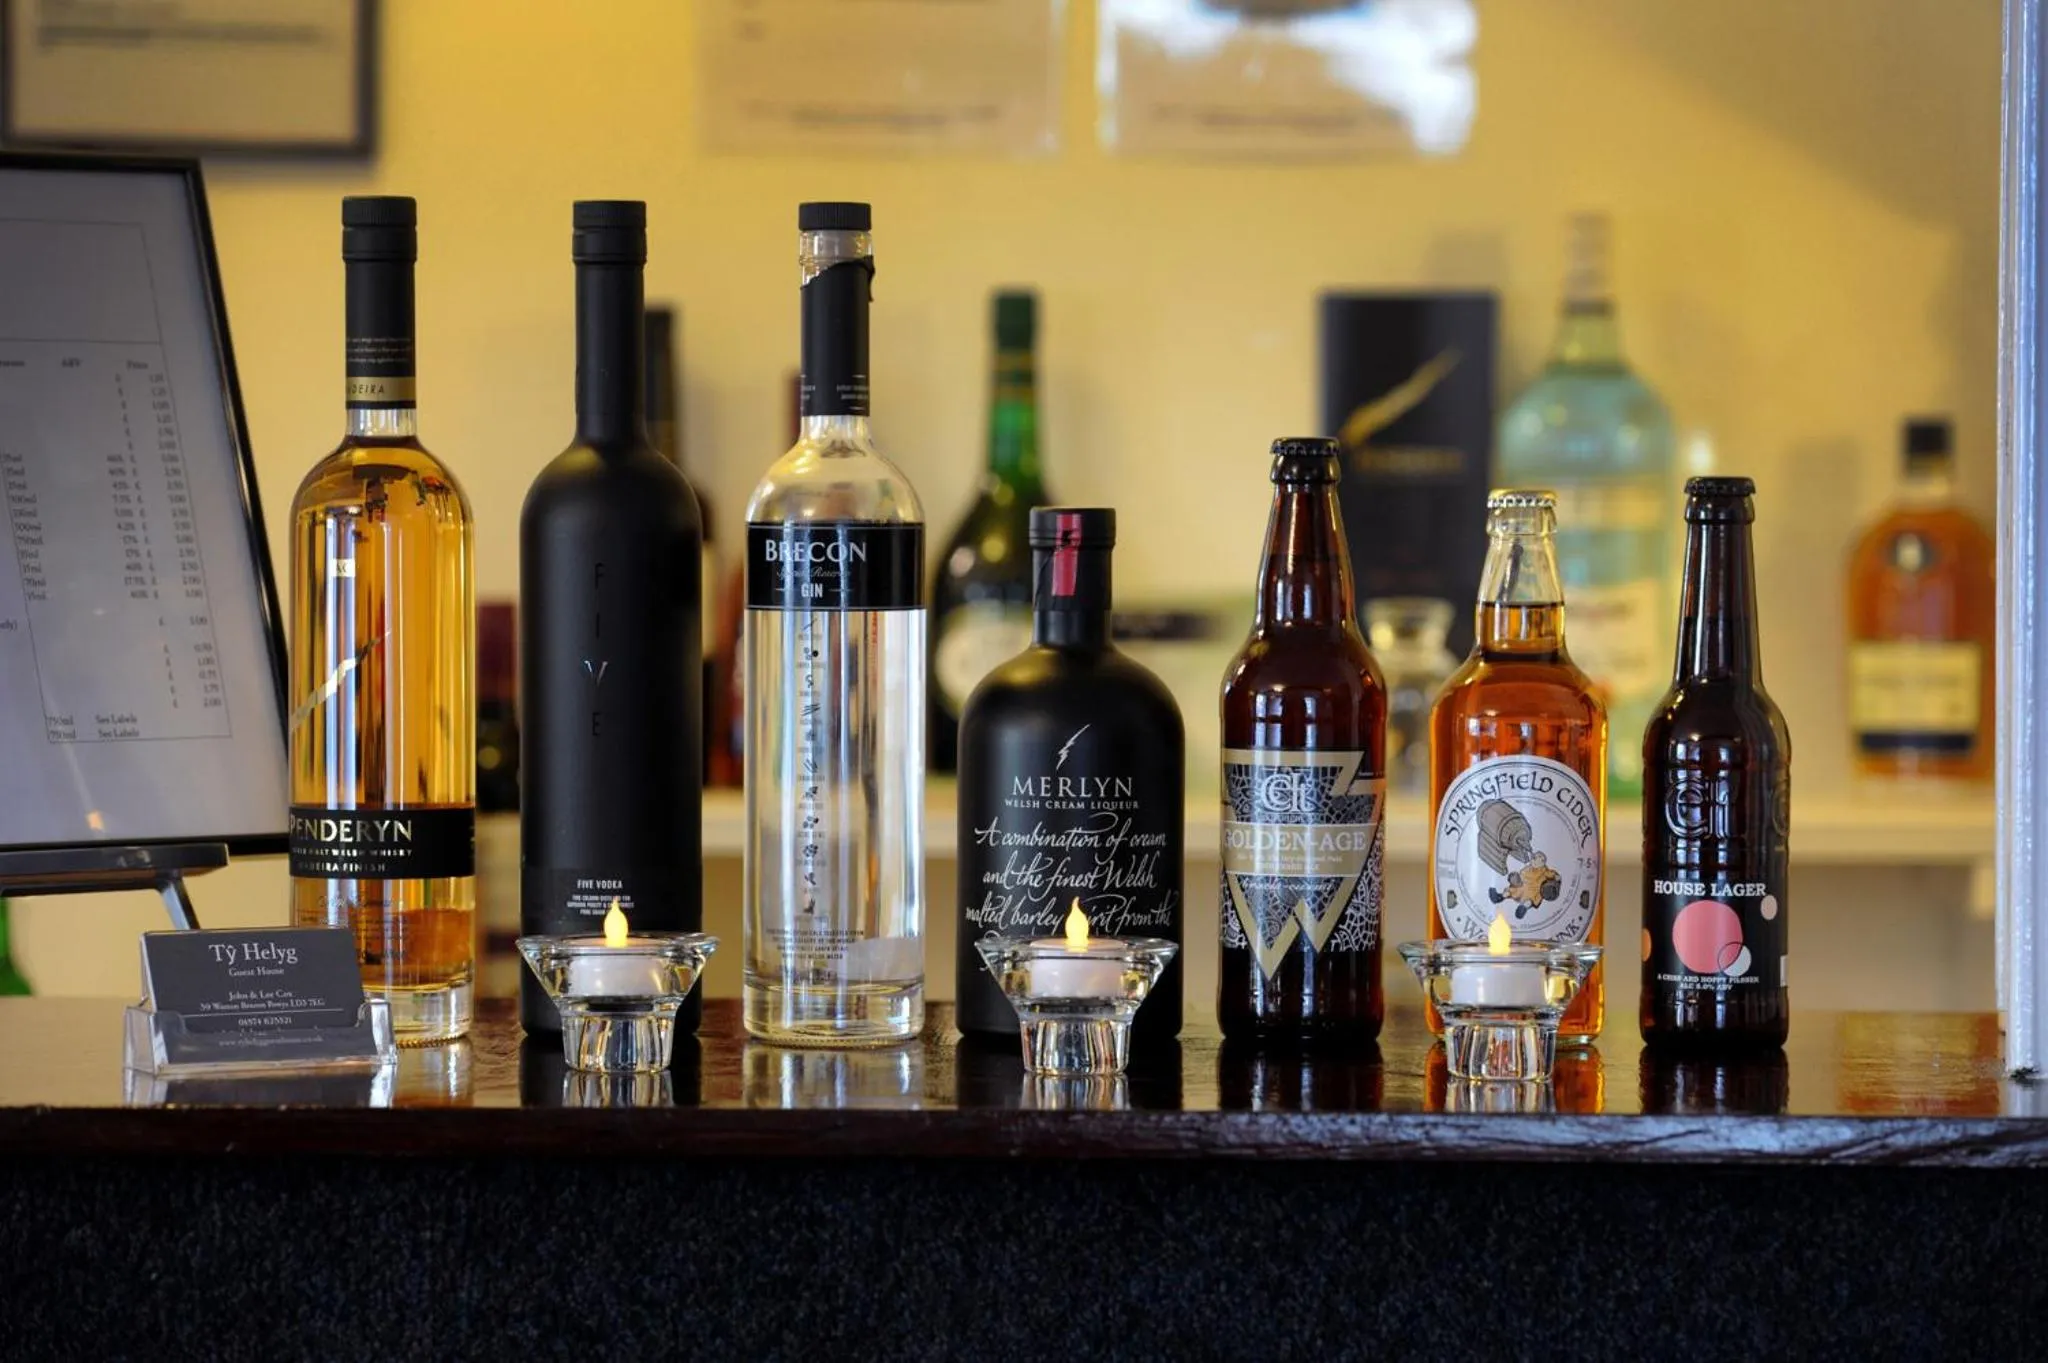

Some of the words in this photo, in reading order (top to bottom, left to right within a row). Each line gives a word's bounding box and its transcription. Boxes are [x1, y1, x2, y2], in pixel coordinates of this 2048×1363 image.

[765, 539, 867, 563] BRECON
[801, 583, 823, 598] GIN
[1012, 776, 1133, 798] MERLYN
[1004, 799, 1040, 809] WELSH
[1045, 800, 1085, 810] CREAM
[1091, 800, 1140, 811] LIQUEUR
[1445, 771, 1554, 843] SPRINGFIELD
[1556, 787, 1593, 849] CIDER
[290, 814, 412, 842] PENDERYN
[974, 816, 1001, 847] A
[983, 850, 1018, 890] and
[1011, 852, 1053, 888] the
[1099, 851, 1161, 892] Welsh
[596, 879, 624, 889] VODKA
[1654, 879, 1706, 897] HOUSE
[1710, 882, 1767, 897] LAGER
[208, 942, 238, 966] Tŷ
[242, 942, 299, 965] Helyg
[228, 967, 255, 978] Guest
[256, 966, 285, 976] House
